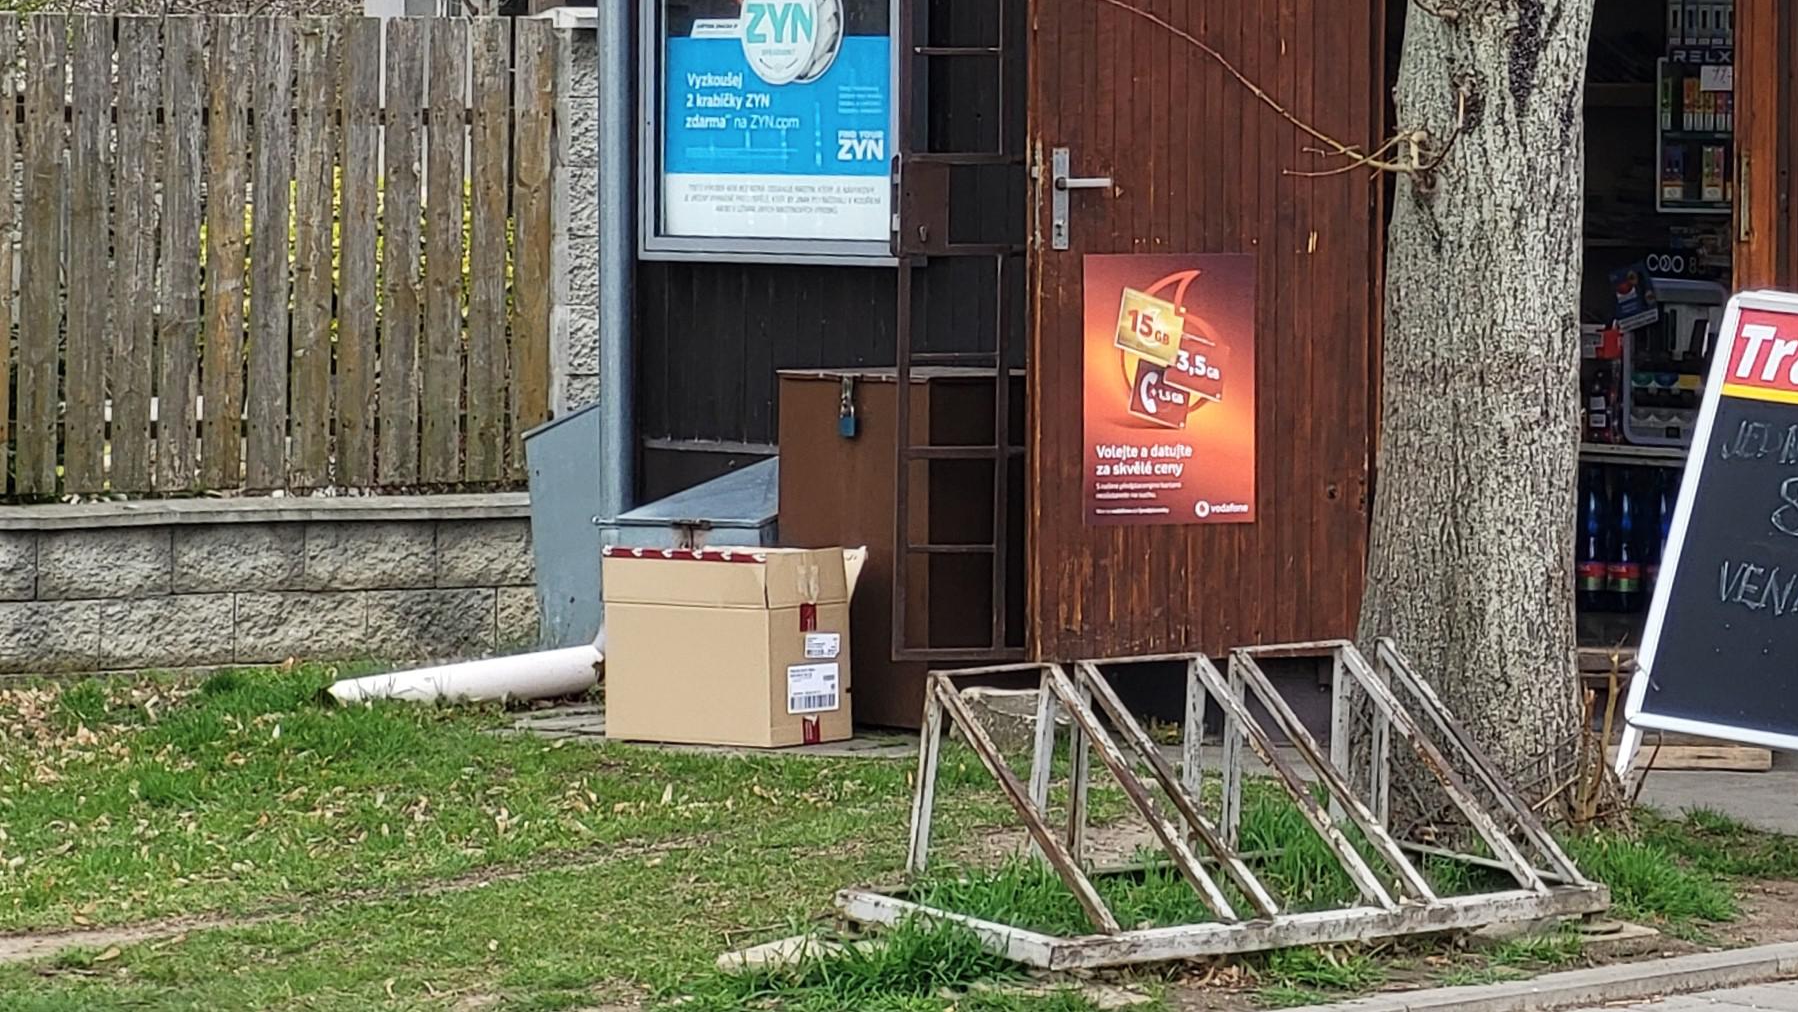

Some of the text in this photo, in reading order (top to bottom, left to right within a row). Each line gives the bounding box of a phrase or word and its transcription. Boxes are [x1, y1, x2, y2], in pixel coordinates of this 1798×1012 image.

[745, 2, 815, 44] ZYN
[1672, 50, 1732, 63] RELX
[687, 72, 743, 89] Vyzkoušej
[686, 94, 770, 110] 2 krabičky ZYN
[734, 117, 747, 129] na
[750, 115, 800, 130] ZYN.com
[836, 139, 884, 160] ZYN
[1127, 309, 1170, 345] 15 GB
[1176, 349, 1206, 377] 3,5
[1096, 444, 1192, 460] Volejte a datujte
[1096, 461, 1184, 477] za skvělé ceny
[1211, 502, 1248, 513] vodafone
